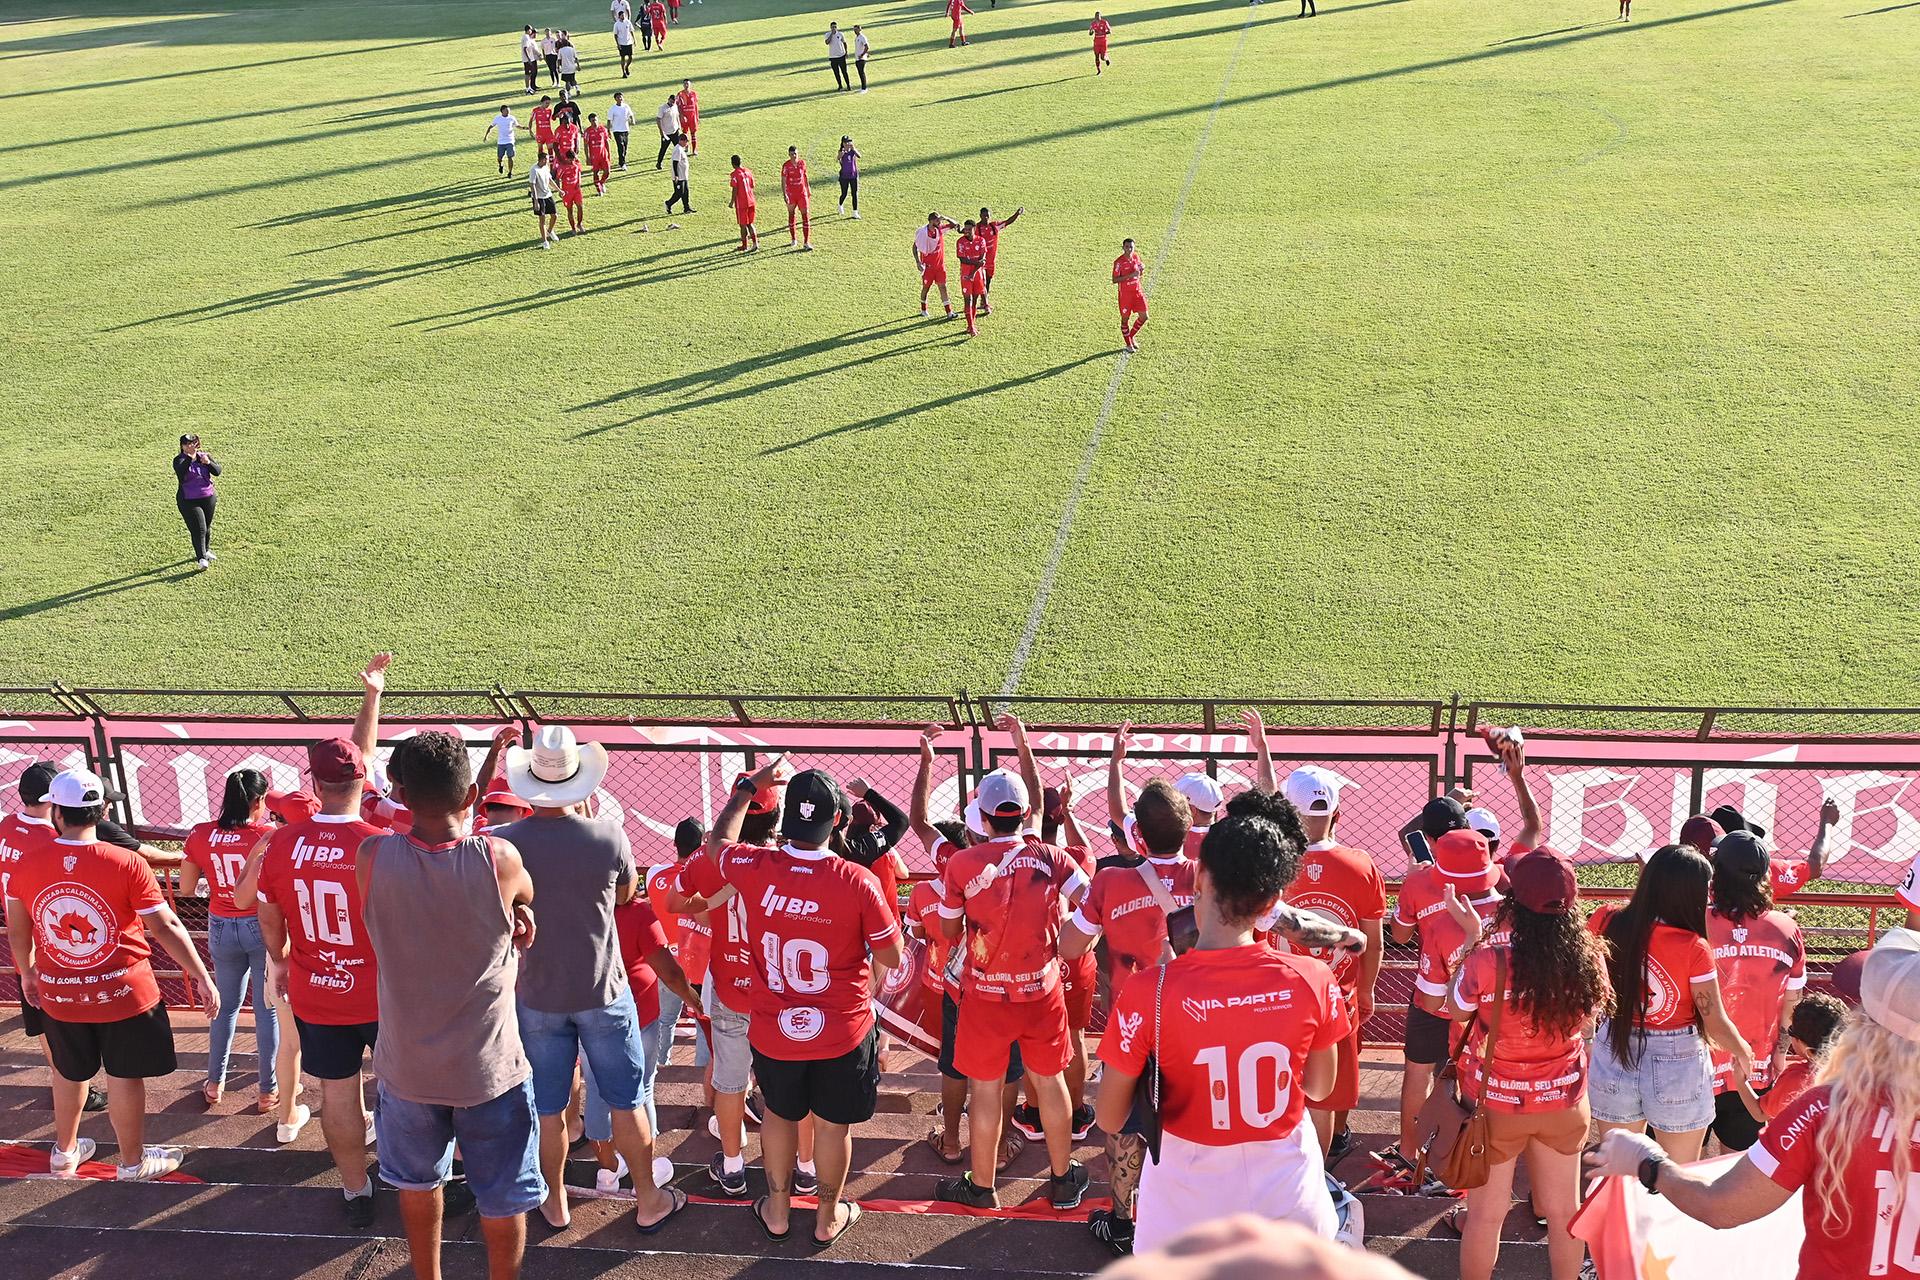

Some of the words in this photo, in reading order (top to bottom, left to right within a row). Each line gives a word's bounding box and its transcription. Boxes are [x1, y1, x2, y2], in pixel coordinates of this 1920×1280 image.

[222, 834, 241, 843] BP
[314, 846, 345, 862] BP
[312, 861, 356, 871] seguradora
[293, 879, 355, 946] 10
[785, 897, 820, 915] BP
[1111, 895, 1160, 920] CALDEIRA
[1416, 901, 1448, 920] CALDEIR
[784, 911, 832, 925] seguradora
[761, 931, 831, 995] 10
[84, 976, 99, 984] SEU
[1015, 972, 1031, 982] SEU
[1227, 989, 1293, 1008] PARTS
[1192, 1041, 1293, 1130] 10
[1534, 1079, 1552, 1091] SEU
